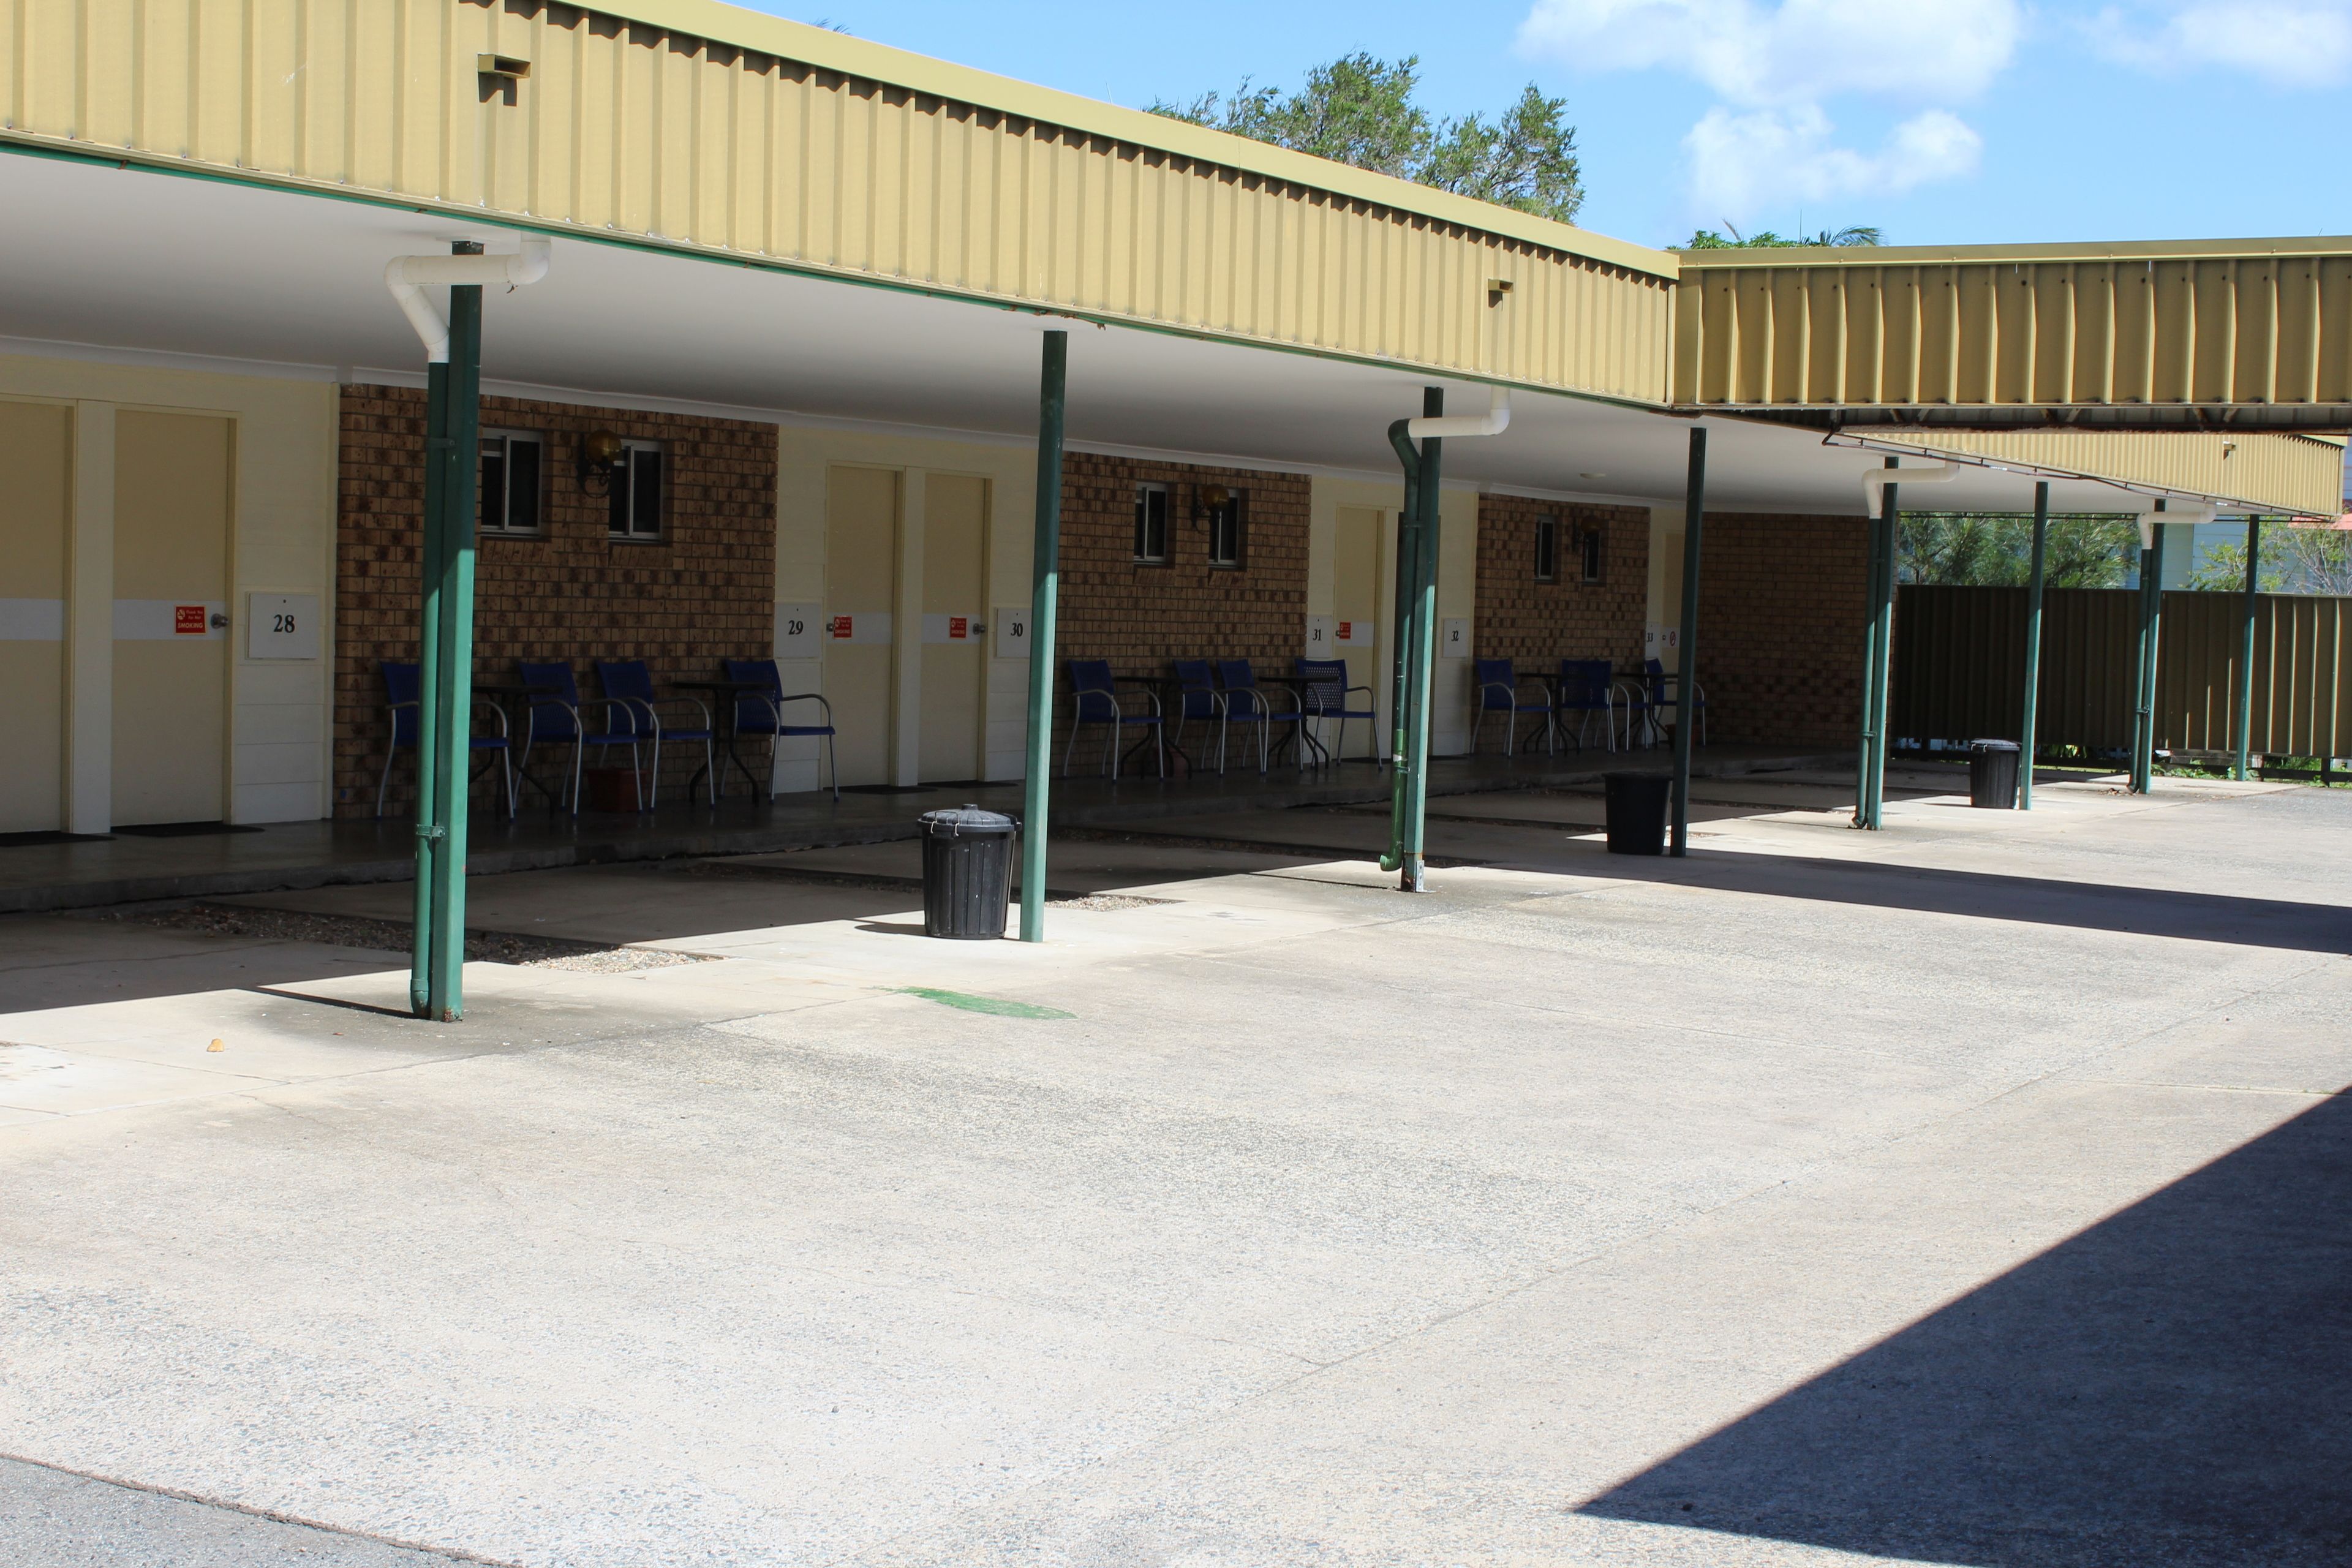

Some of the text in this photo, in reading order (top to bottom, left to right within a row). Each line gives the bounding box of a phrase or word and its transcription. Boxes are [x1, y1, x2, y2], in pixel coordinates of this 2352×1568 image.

[273, 614, 295, 633] 28
[788, 620, 804, 635] 29
[1010, 622, 1023, 637] 30
[1313, 628, 1322, 641] 31
[1450, 630, 1459, 641] 32
